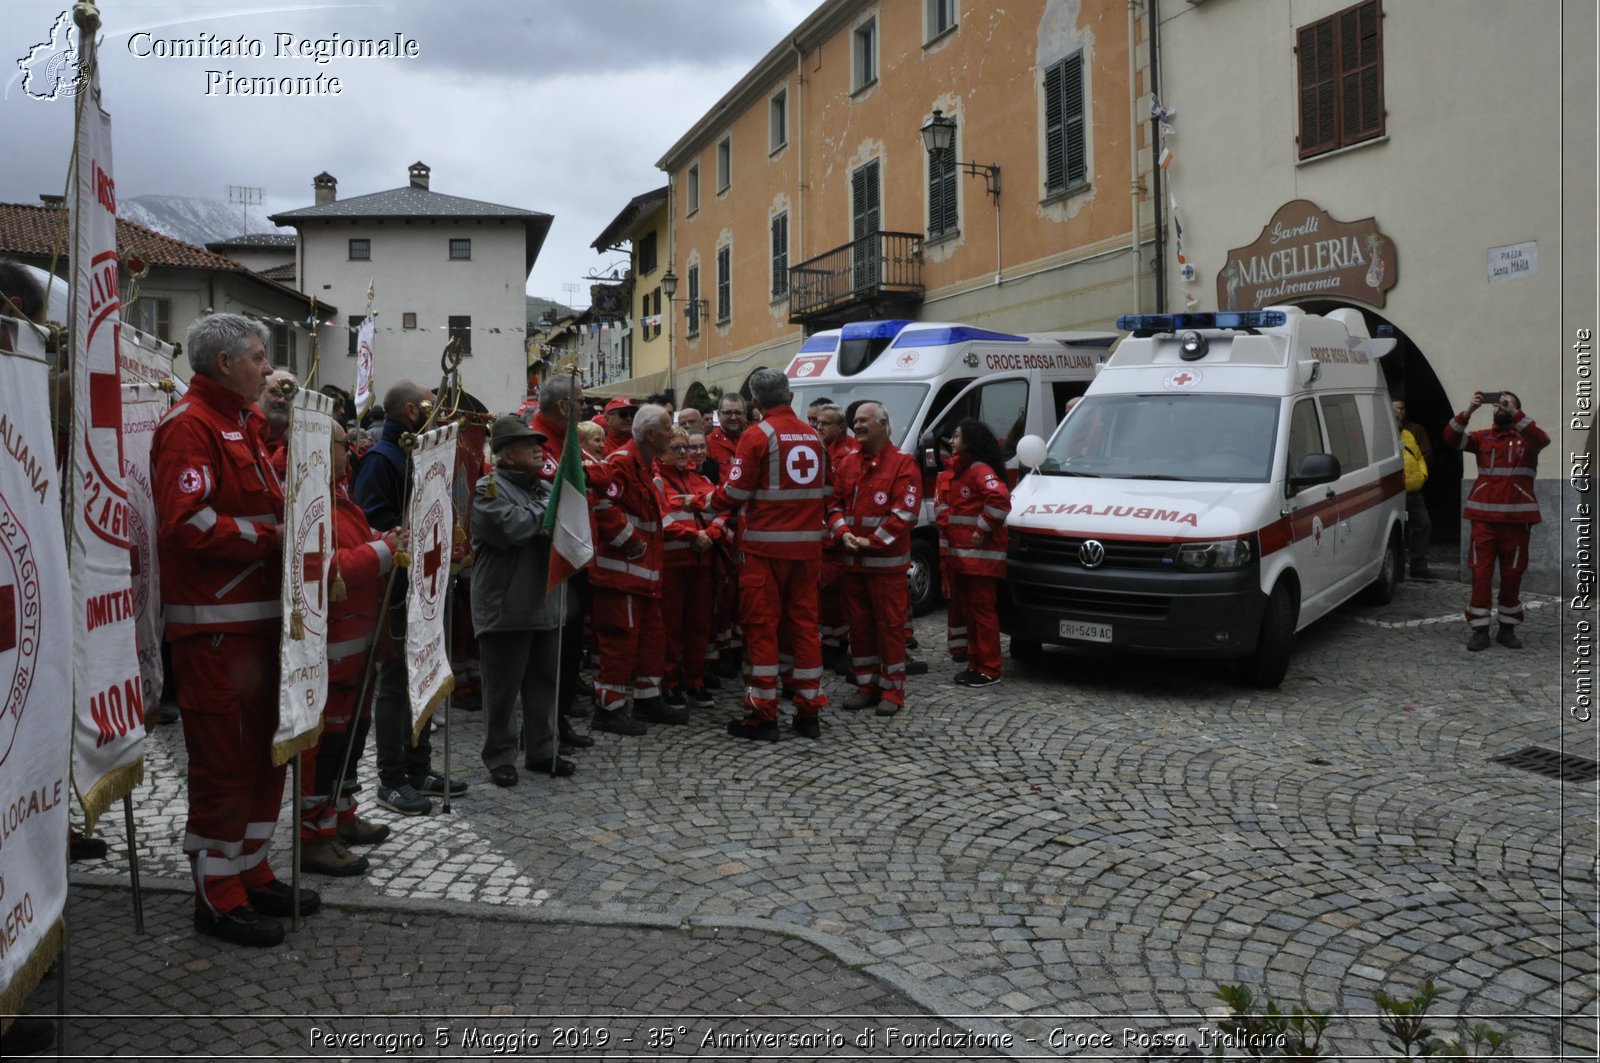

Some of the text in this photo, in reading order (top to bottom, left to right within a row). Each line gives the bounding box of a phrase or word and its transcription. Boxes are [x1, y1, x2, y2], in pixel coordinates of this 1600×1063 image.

[1270, 215, 1320, 245] Garelli
[1238, 235, 1367, 288] MACELLERIA
[1254, 275, 1341, 308] gastronomia
[985, 353, 1095, 370] CROCE ROSSA ITALIANA
[0, 511, 38, 720] 22 AGOSTO 1864
[1060, 623, 1075, 635] CRI
[1099, 627, 1112, 639] AC
[3, 778, 63, 841] LOCALE
